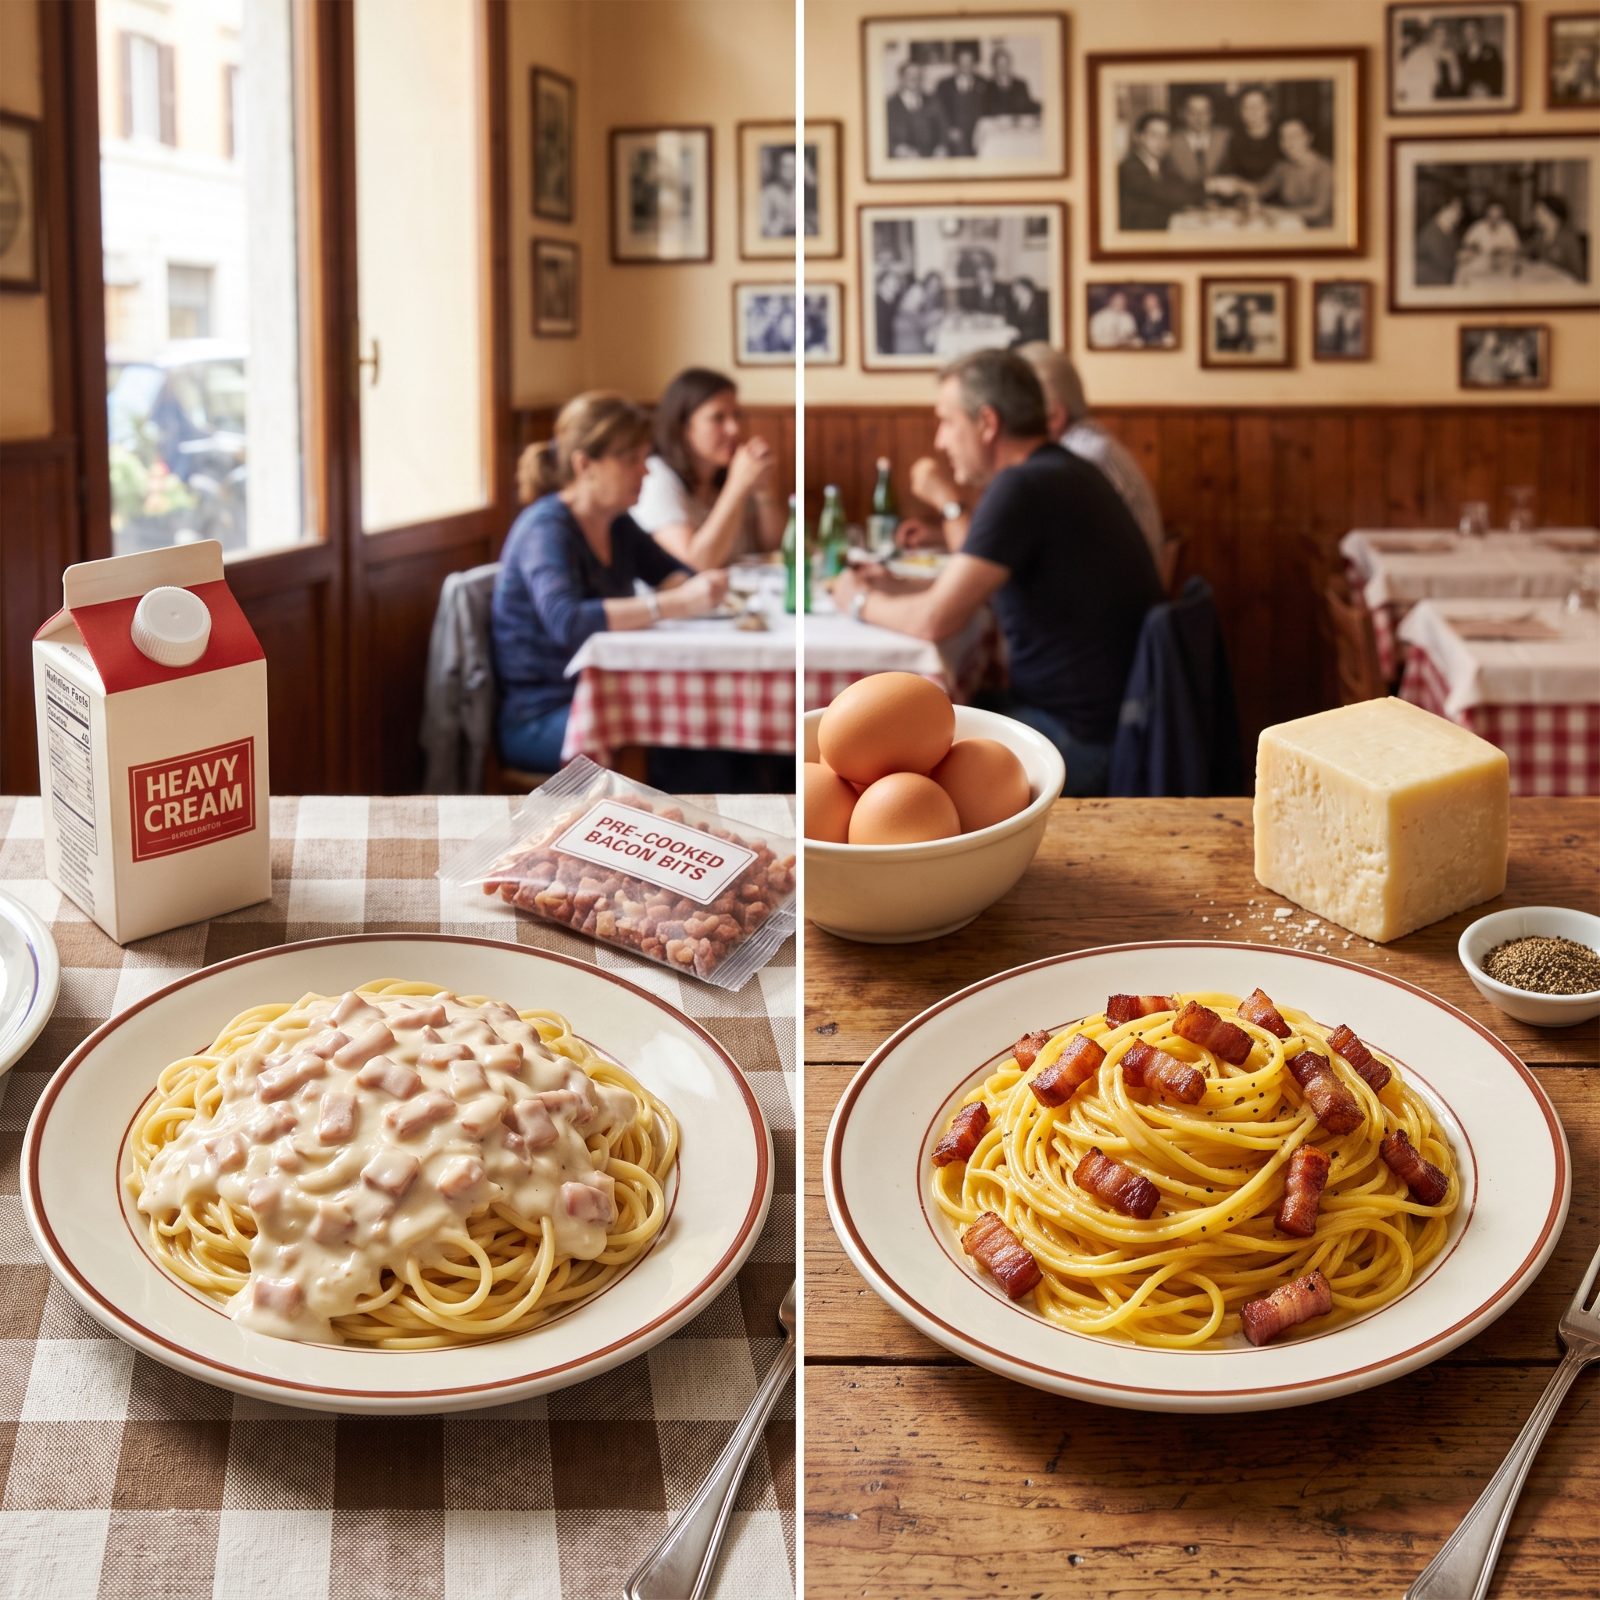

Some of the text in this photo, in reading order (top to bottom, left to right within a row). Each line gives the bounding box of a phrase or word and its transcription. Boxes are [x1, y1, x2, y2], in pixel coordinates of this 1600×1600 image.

[71, 687, 89, 708] Facts
[146, 754, 239, 802] HEAVY
[144, 783, 243, 833] CREAM
[584, 830, 707, 881] BACON BITS
[596, 817, 725, 868] PRE-COOKED
